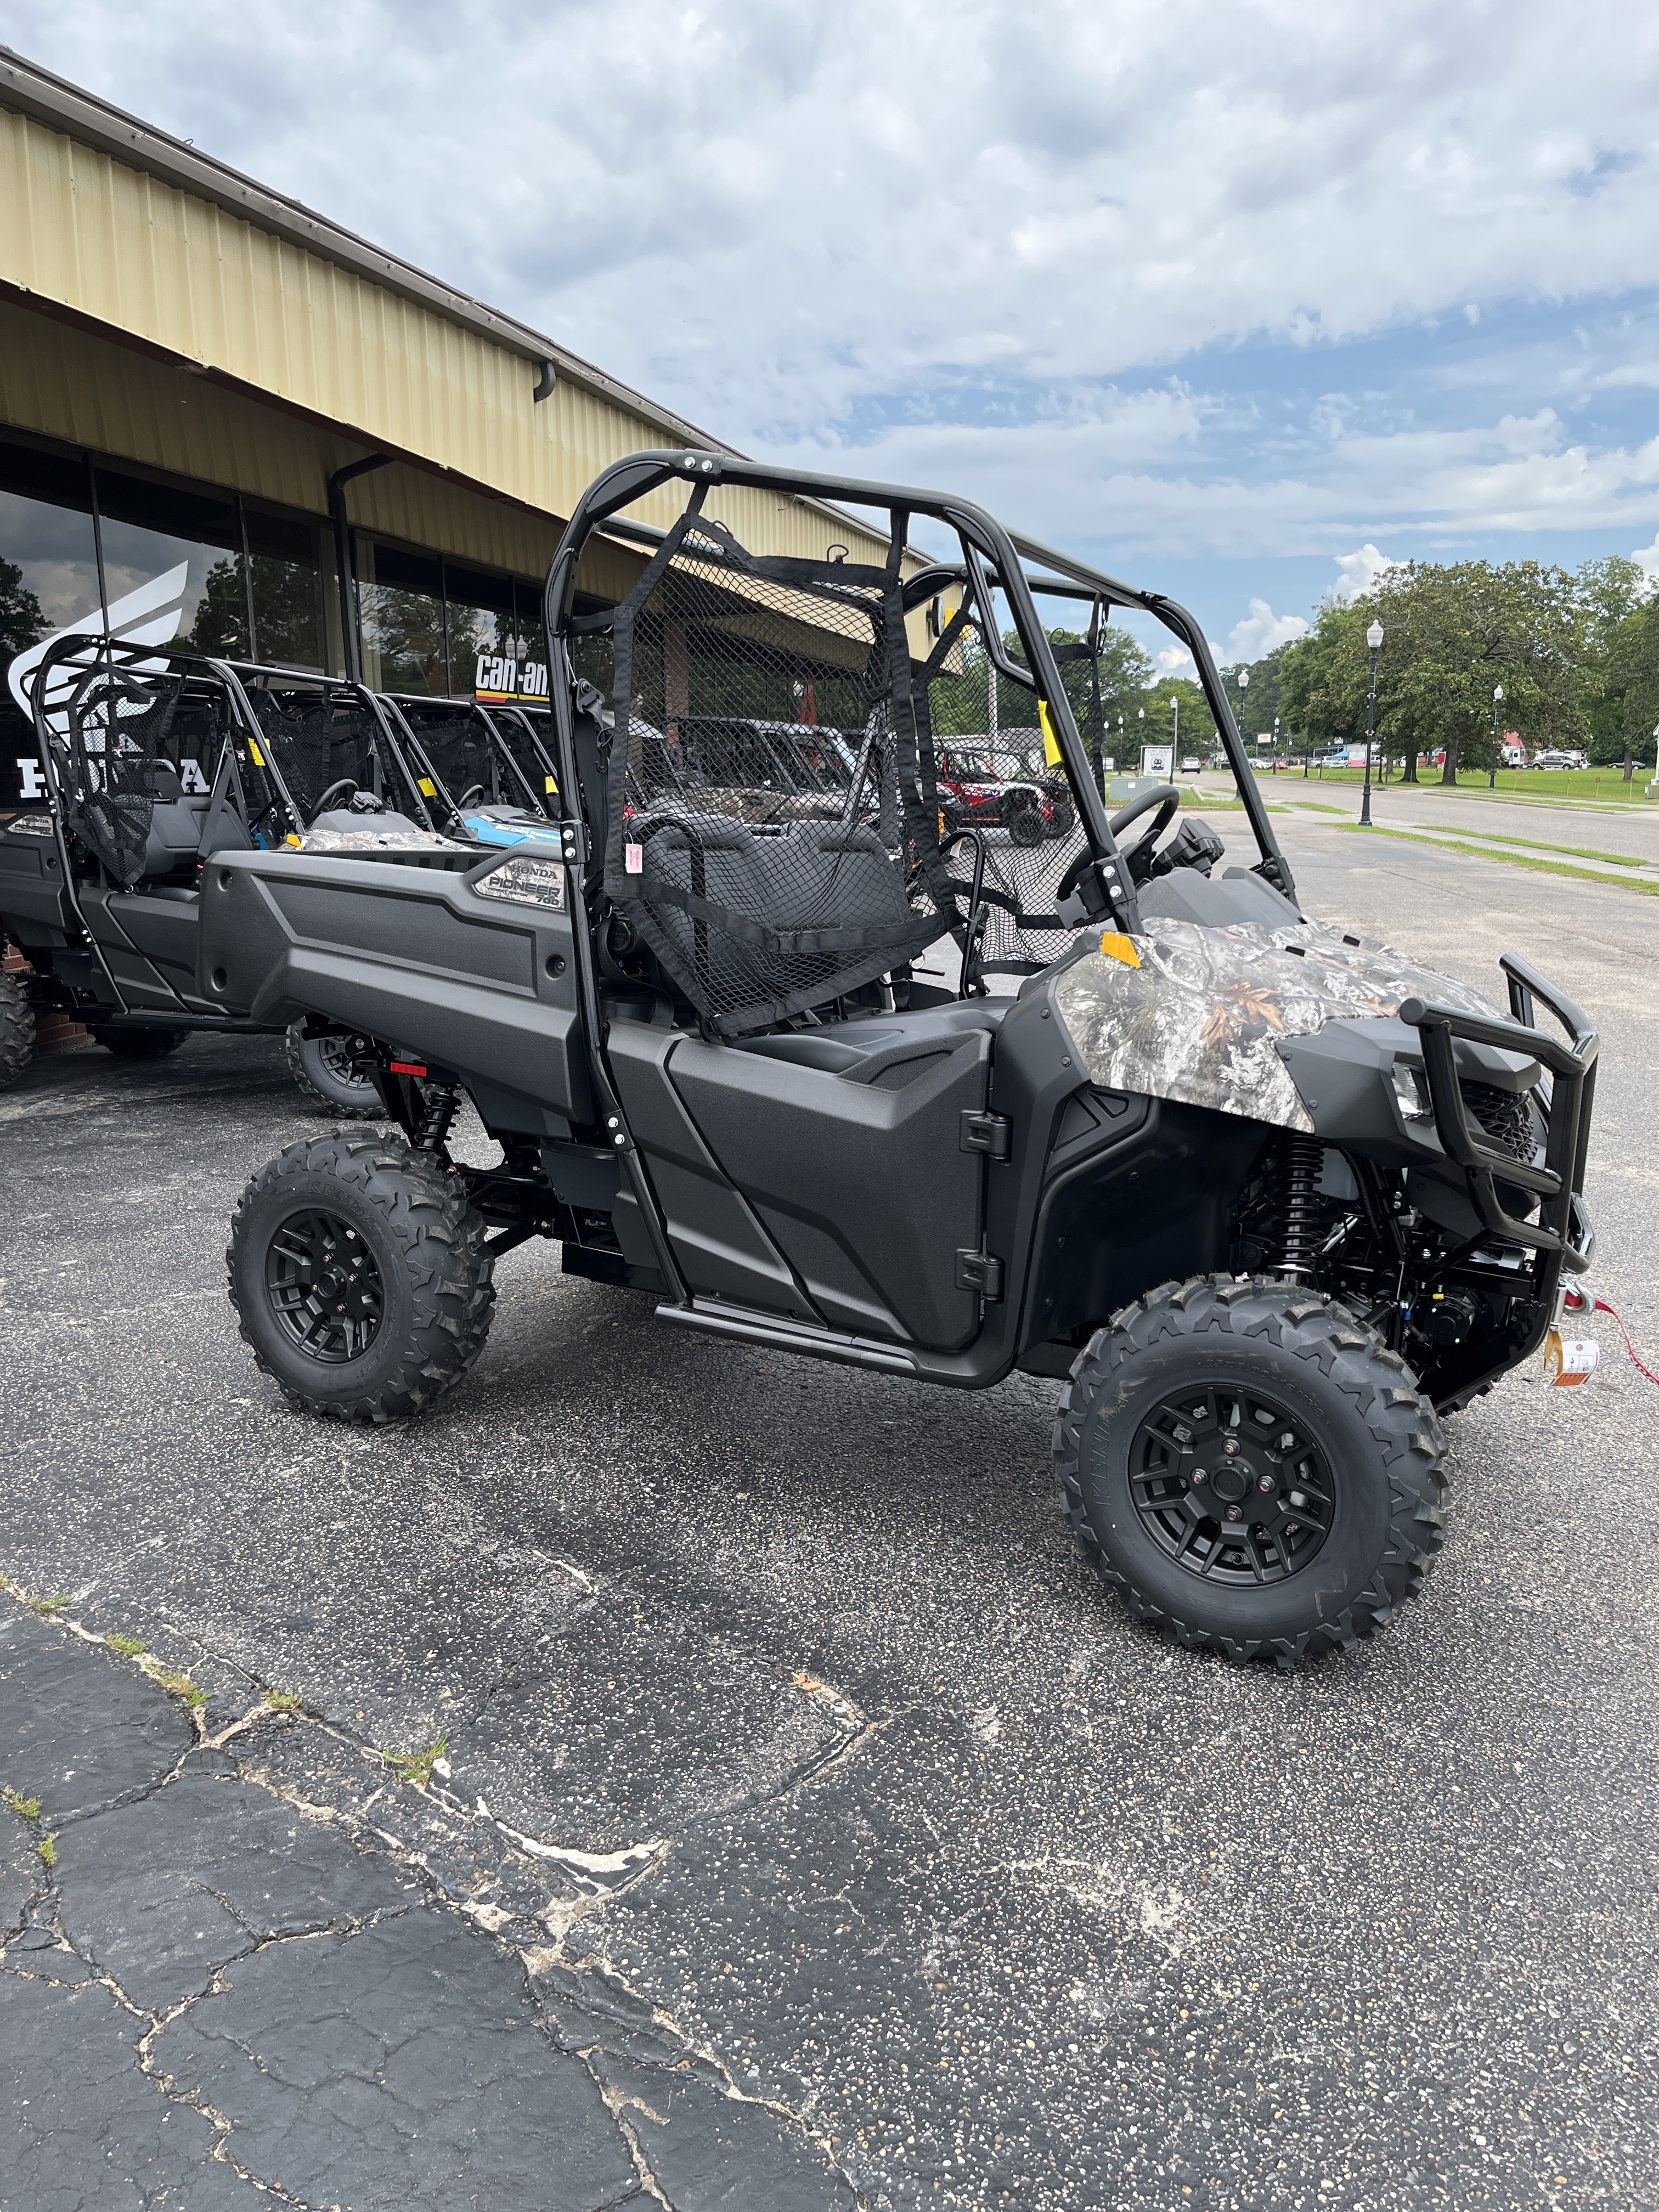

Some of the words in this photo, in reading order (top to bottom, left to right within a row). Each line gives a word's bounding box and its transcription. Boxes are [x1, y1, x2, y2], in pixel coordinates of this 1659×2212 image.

[511, 865, 558, 879] HONDA
[489, 876, 561, 898] PIONEER
[535, 895, 560, 906] 700
[307, 1180, 377, 1231] KENDA
[1090, 1394, 1129, 1506] KENDA
